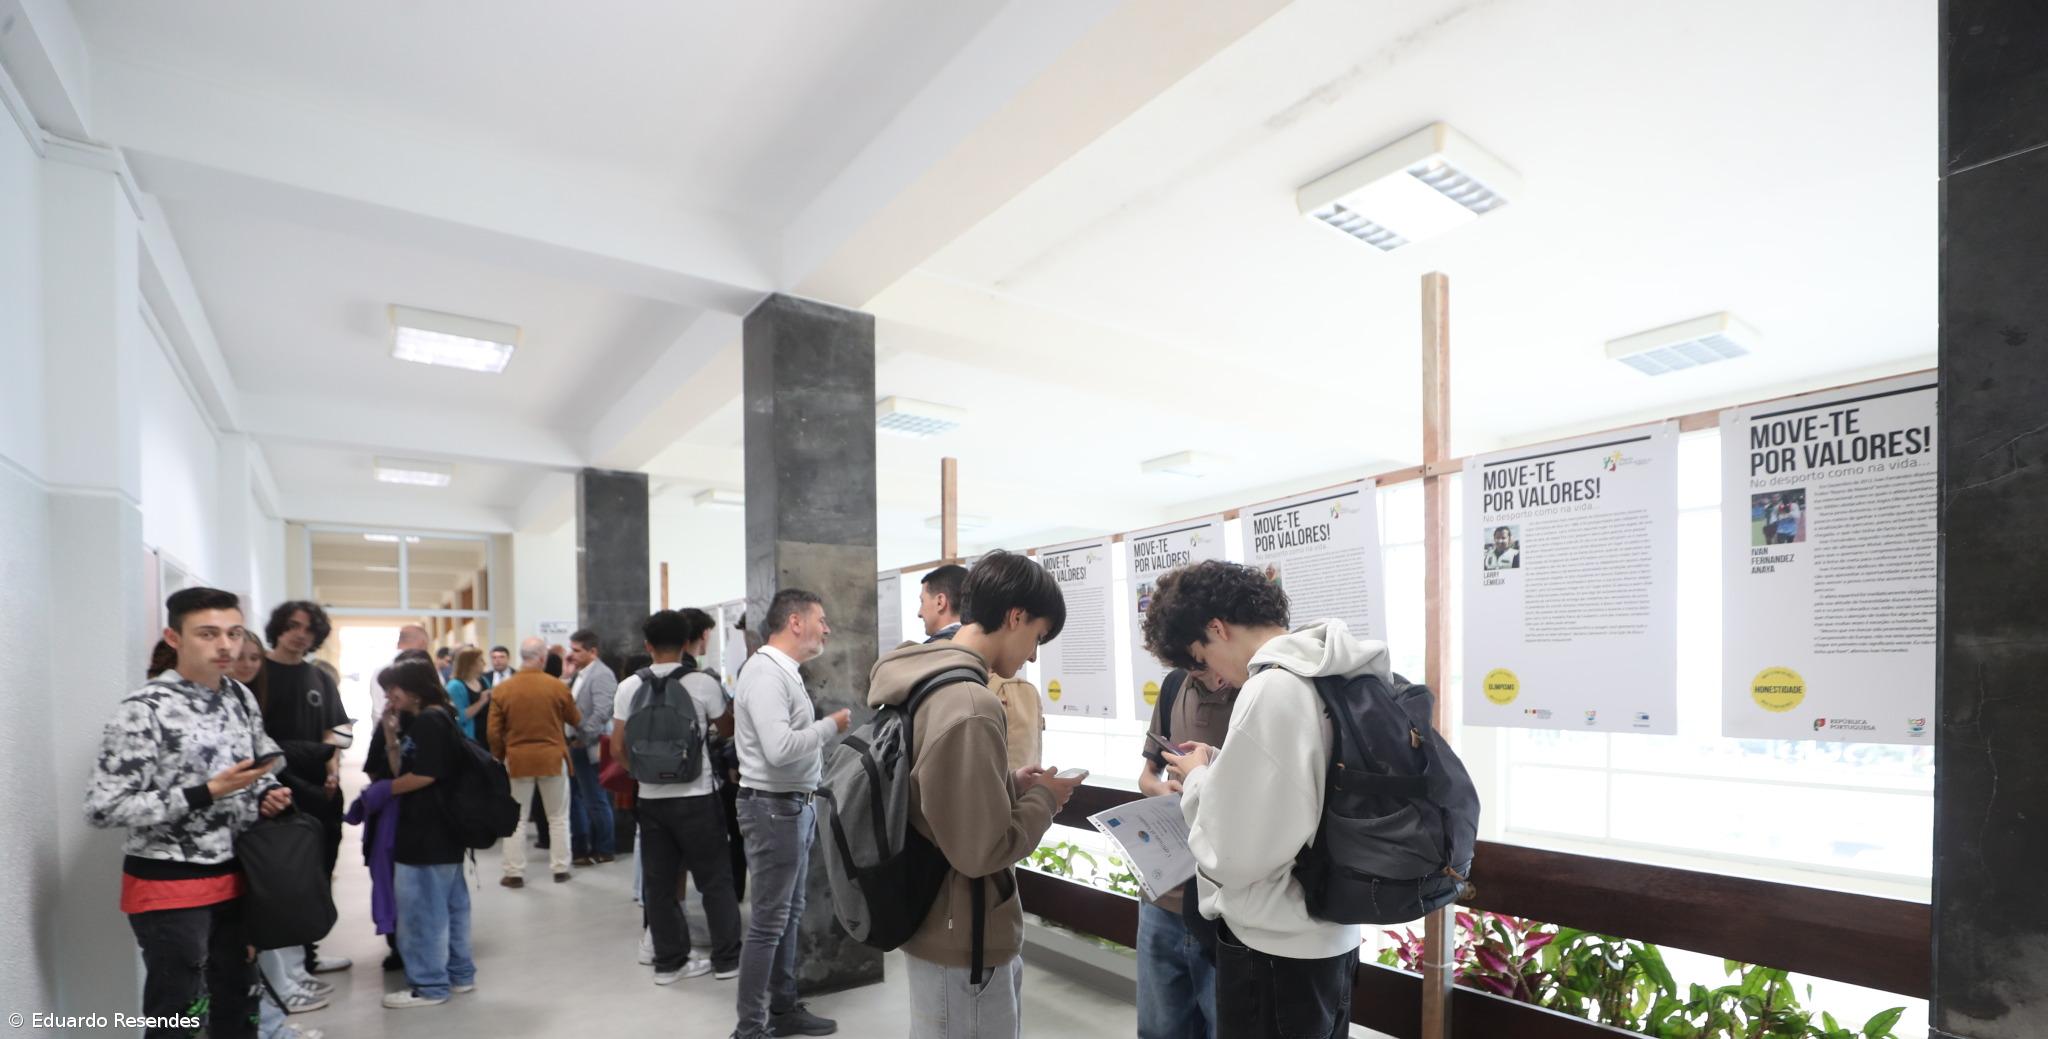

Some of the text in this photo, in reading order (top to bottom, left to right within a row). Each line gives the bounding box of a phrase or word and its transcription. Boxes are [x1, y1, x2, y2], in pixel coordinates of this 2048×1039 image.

[1750, 408, 1860, 450] MOVE-TE
[1751, 426, 1931, 477] POR VALORES!
[1483, 461, 1555, 491] MOVE-TE
[1750, 456, 1930, 488] No desporto como na vida...
[1483, 477, 1600, 513] POR VALORES!
[1253, 511, 1300, 535] MOVE-TE
[1496, 509, 1533, 522] desporto
[1535, 507, 1558, 517] como
[1560, 505, 1571, 514] na
[1133, 538, 1168, 558] MOVE-TE
[1255, 523, 1331, 553] POR VALORES!
[1043, 554, 1070, 570] MOVE-TE
[1135, 550, 1191, 573] POR VALORES!
[1751, 547, 1768, 556] IVAN
[1751, 553, 1795, 565] FERNANDEZ
[1056, 566, 1087, 582] VALORES!
[1751, 565, 1775, 575] ANAYA
[1754, 685, 1803, 695] HONESTIDADE
